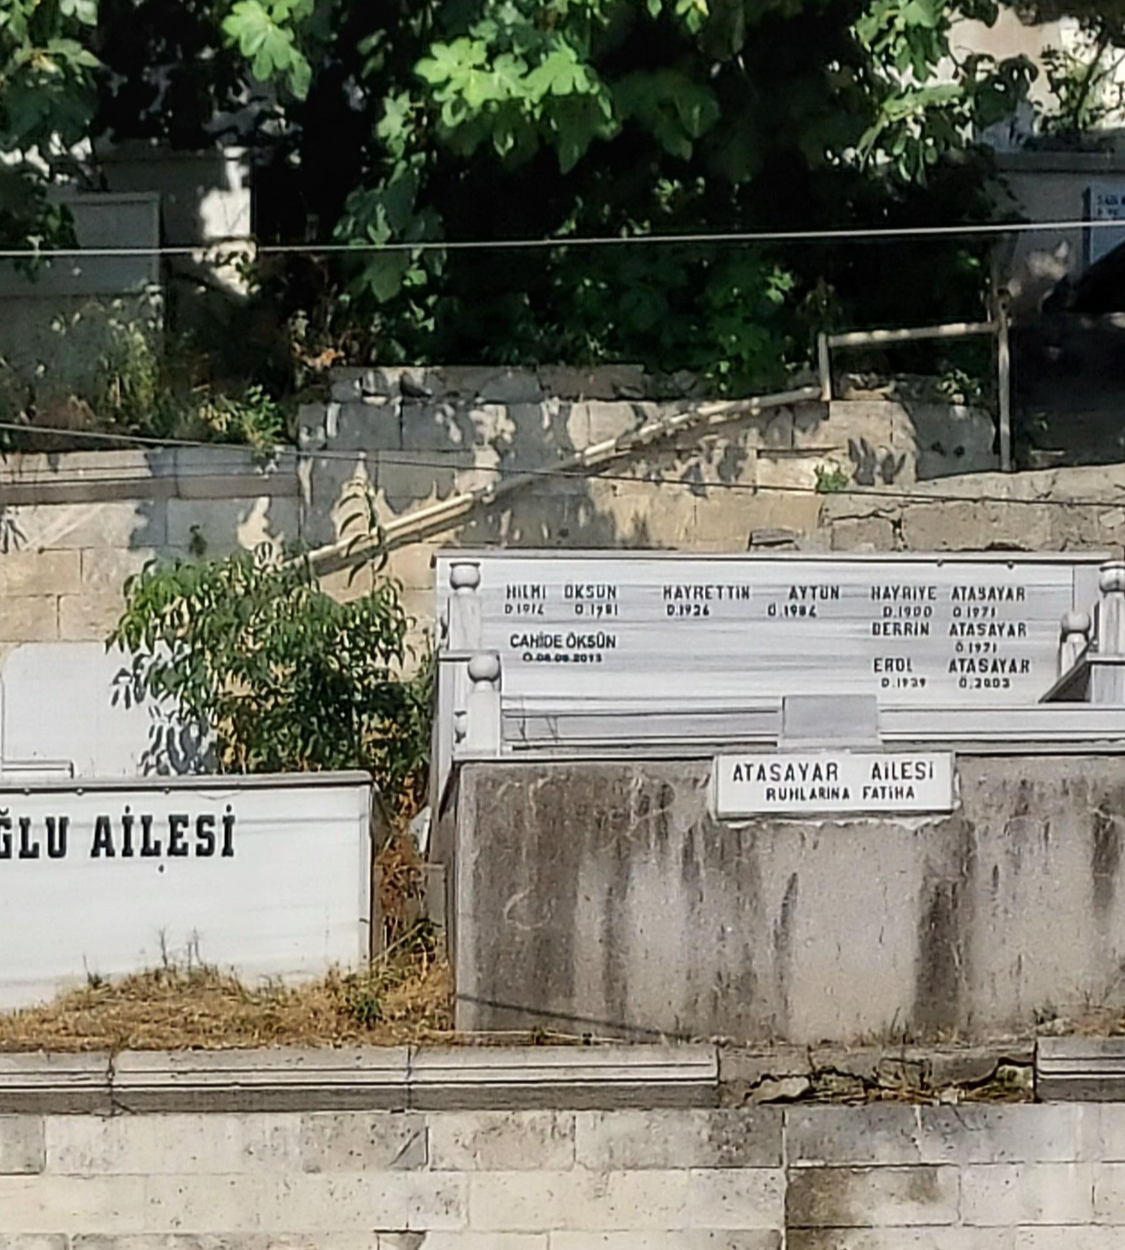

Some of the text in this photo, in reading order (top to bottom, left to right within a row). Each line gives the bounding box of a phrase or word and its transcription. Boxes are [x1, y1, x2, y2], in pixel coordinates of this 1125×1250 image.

[949, 622, 1026, 637] ATASAYAR
[948, 658, 1030, 673] ATASAYAR
[733, 761, 934, 782] ATASAYAR AİLESİ
[863, 785, 915, 800] FATİHA
[90, 804, 236, 858] AİLESİ
